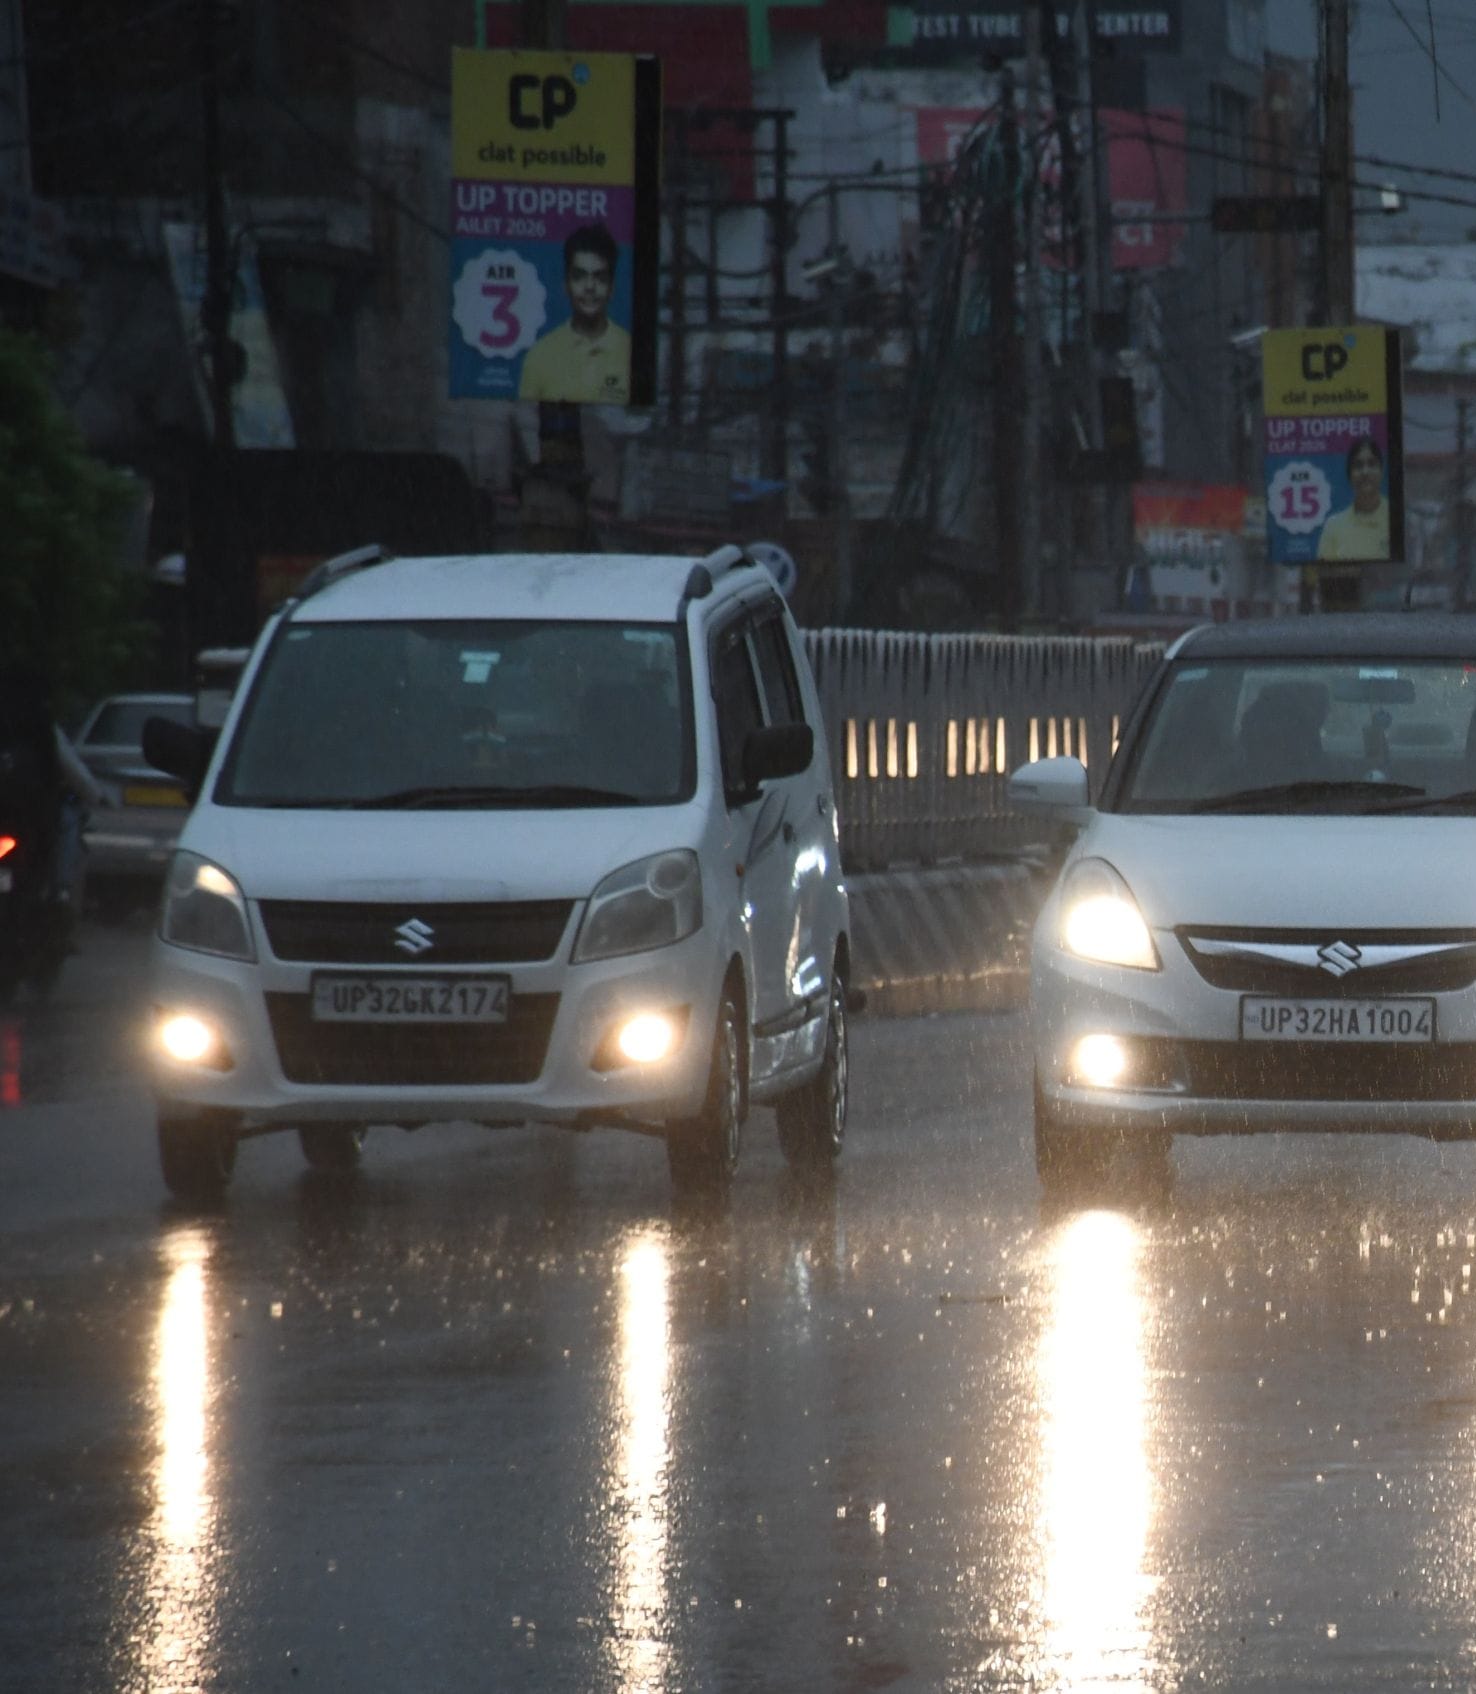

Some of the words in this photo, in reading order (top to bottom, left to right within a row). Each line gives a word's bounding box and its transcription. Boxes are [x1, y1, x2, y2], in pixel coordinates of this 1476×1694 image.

[509, 73, 577, 130] CP
[478, 141, 515, 164] clat
[522, 144, 607, 168] possible
[456, 184, 497, 213] UP
[503, 186, 608, 218] TOPPER
[456, 217, 502, 235] AILET
[506, 218, 546, 237] 2026
[486, 264, 515, 280] AIR
[479, 284, 521, 350] 3
[1301, 343, 1348, 381] CP
[1312, 387, 1369, 406] possible
[1267, 419, 1295, 438] UP
[1299, 418, 1372, 436] TOPPER
[1279, 485, 1321, 520] 15
